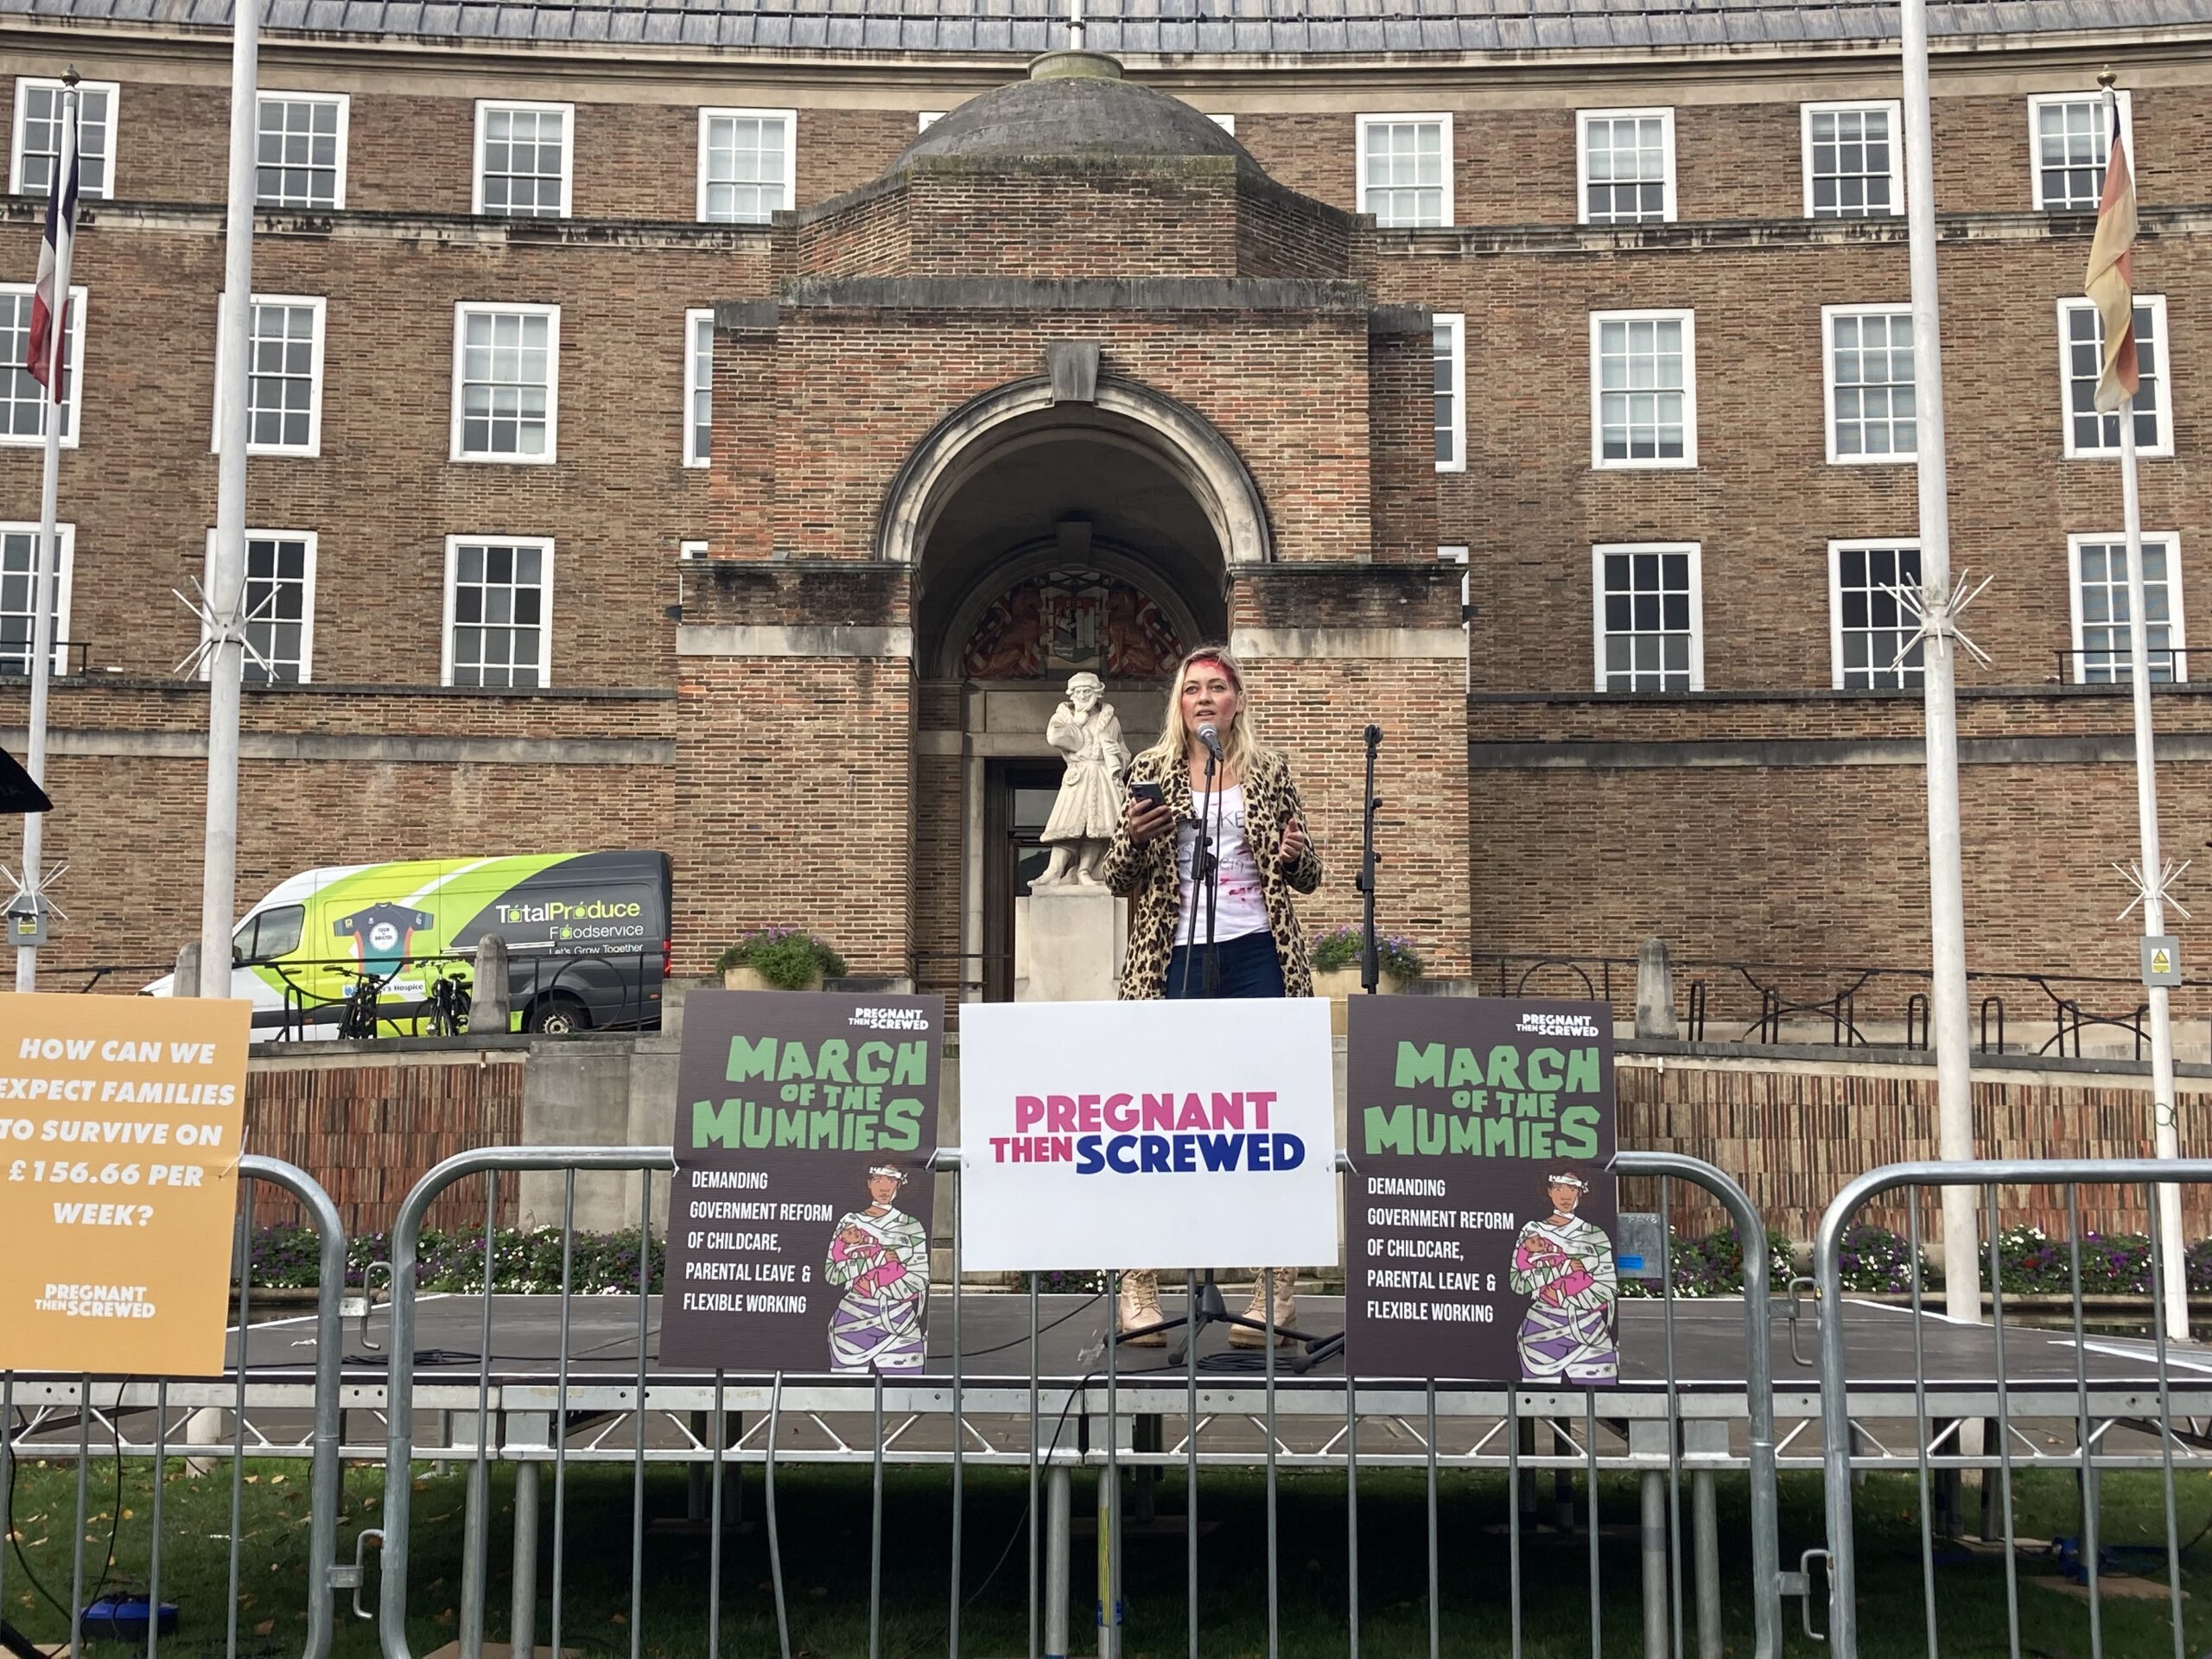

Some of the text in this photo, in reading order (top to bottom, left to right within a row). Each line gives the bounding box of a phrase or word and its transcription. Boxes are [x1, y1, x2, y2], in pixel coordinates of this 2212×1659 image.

[574, 945, 601, 955] Grow
[602, 944, 644, 955] Together
[394, 982, 423, 992] Hospice
[855, 1007, 923, 1020] PREGNANT
[869, 1018, 929, 1030] SCREWED
[1522, 1014, 1592, 1026] PREGNANT
[1538, 1025, 1599, 1037] SCREWED
[19, 1039, 216, 1065] HOW CAN WE
[725, 1035, 927, 1086] MARCH
[1395, 1040, 1600, 1093] MARCH
[0, 1078, 236, 1106] EXPECT FAMILIES
[780, 1084, 882, 1112] OF THE
[1015, 1091, 1277, 1133] PREGNANT
[1452, 1090, 1556, 1118] OF THE
[0, 1119, 223, 1146] TO SURVIVE ON
[692, 1097, 925, 1152] MUMMIES
[1363, 1104, 1601, 1160] MUMMIES
[989, 1133, 1306, 1174] THEN SCREWED
[8, 1160, 204, 1187] £156.66 PER
[692, 1170, 768, 1190] DEMANDING
[1368, 1177, 1446, 1197] DEMANDING
[53, 1202, 154, 1227] WEEK?
[690, 1201, 833, 1222] GOVERNMENT REFORM
[1368, 1208, 1514, 1230] GOVERNMENT REFORM
[688, 1231, 781, 1254] OF CHILDCARE,
[1368, 1238, 1464, 1262] OF CHILDCARE,
[685, 1262, 811, 1283] PARENTAL LEAVE &
[1368, 1269, 1496, 1292] PARENTAL LEAVE &
[45, 1283, 147, 1302] PREGNANT
[683, 1293, 807, 1314] FLEXIBLE WORKING
[35, 1299, 156, 1319] THEN SCREWED
[1367, 1300, 1493, 1323] FLEXIBLE WORKING
